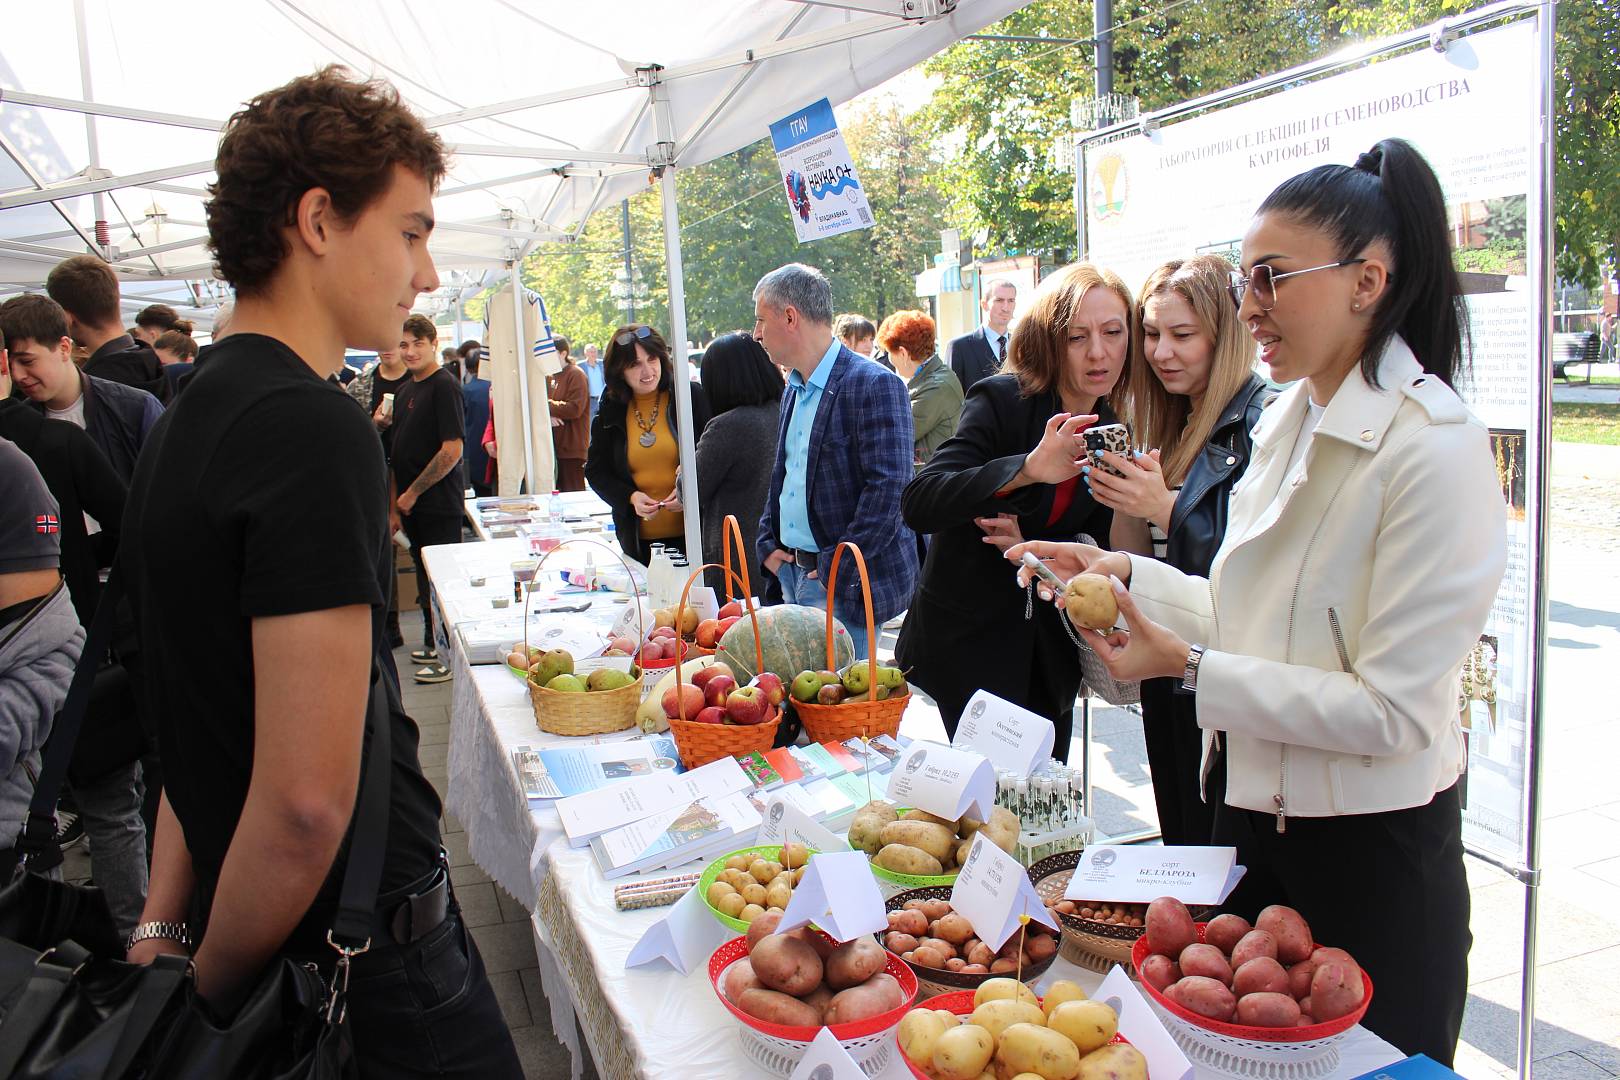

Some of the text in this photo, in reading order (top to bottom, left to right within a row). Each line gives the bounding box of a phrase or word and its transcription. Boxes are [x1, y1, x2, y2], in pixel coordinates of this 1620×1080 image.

[789, 115, 809, 138] ГГАУ
[1156, 77, 1471, 171] ЛАБОРАТОРИЯ СЕЛЕКЦИИ И СЕМЕНОВОДСТВА
[1248, 136, 1331, 169] КАРТОФЕЛЯ
[807, 168, 837, 189] НАУКА
[819, 209, 848, 223] ВЛАДИКАВКАЗ
